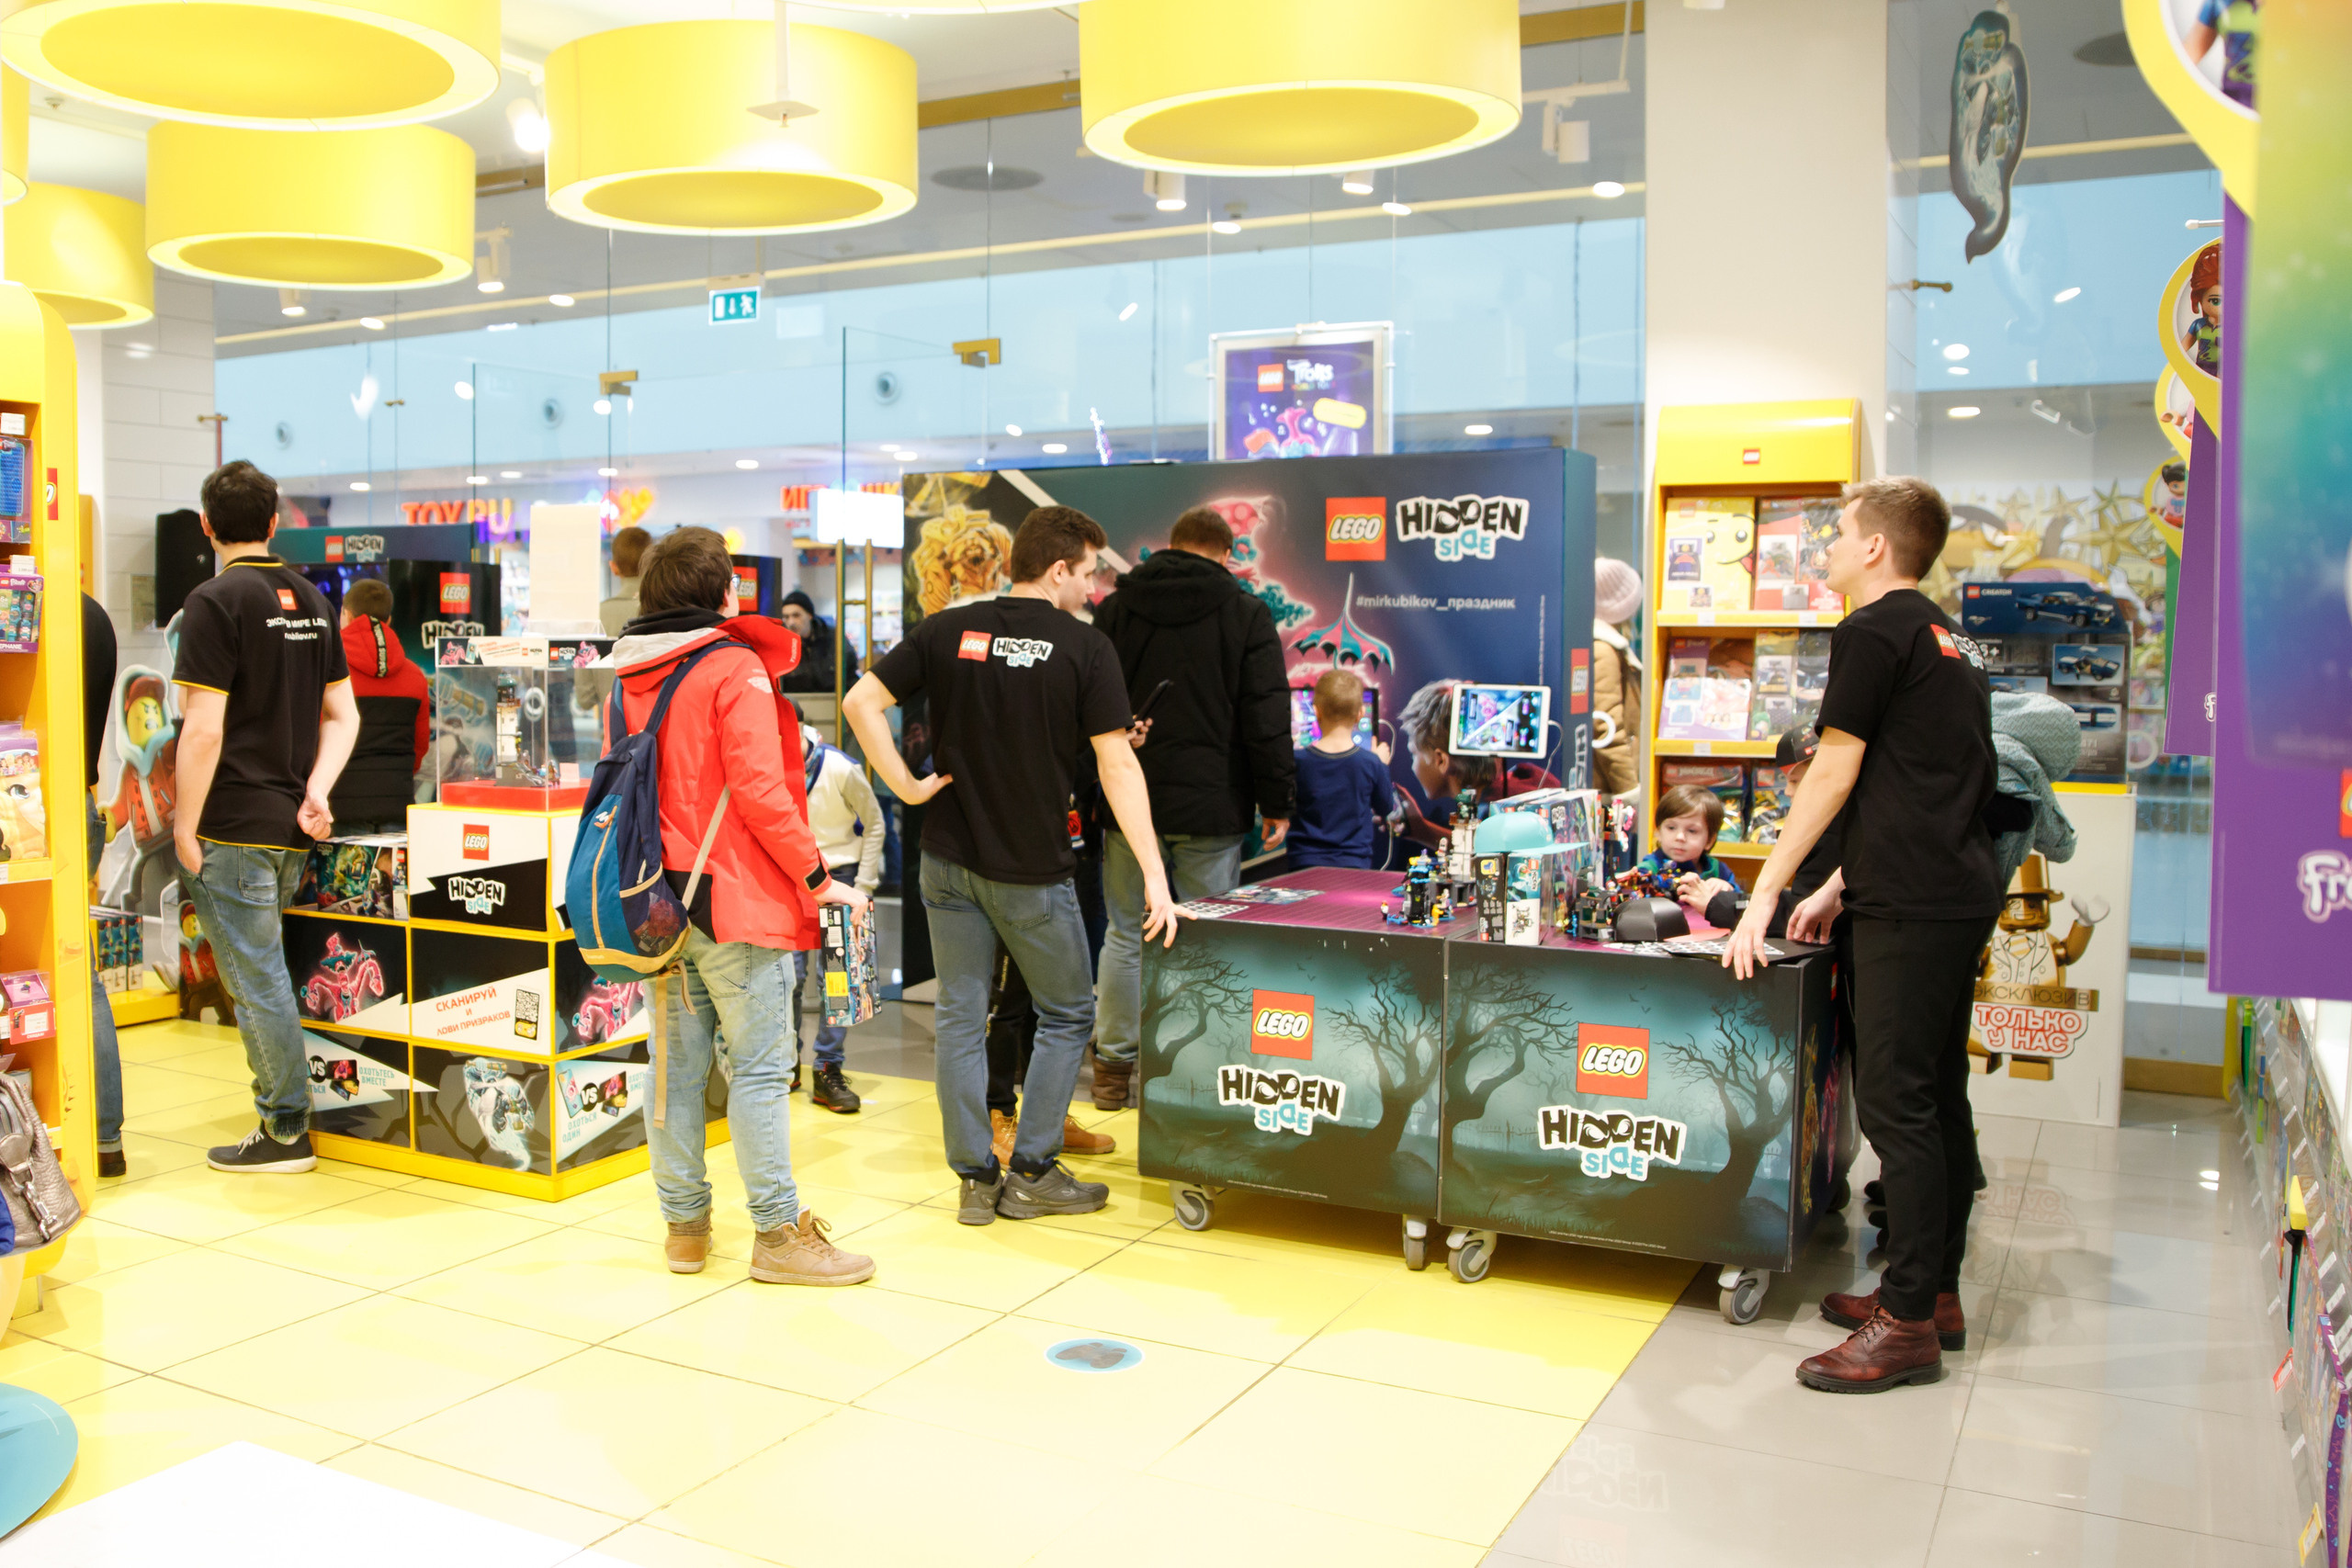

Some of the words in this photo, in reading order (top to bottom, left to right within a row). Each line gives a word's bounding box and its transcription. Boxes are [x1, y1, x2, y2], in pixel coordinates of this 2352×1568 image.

[1330, 516, 1383, 541] LEGO
[1401, 499, 1523, 536] HIDDEN
[1439, 528, 1490, 557] SIDE
[443, 586, 469, 601] LEGO
[960, 638, 989, 652] LEGO
[996, 638, 1050, 658] HIDDEN
[1008, 653, 1032, 666] SIDE
[464, 832, 489, 851] LEGO
[450, 878, 504, 903] HIDDEN
[467, 897, 492, 914] SIDE
[435, 986, 497, 1012] СКАНИРУЙ
[1973, 984, 2092, 1007] ЭКСКЛЮЗИВ
[436, 1023, 459, 1036] ЛОВИ
[460, 1010, 511, 1031] ПРИЗРАКОВ
[465, 1008, 473, 1016] И
[1256, 1010, 1308, 1038] LEGO
[1976, 1005, 2082, 1034] ТОЛЬКО
[1987, 1028, 2006, 1047] У
[2011, 1030, 2068, 1054] НАС
[308, 1060, 326, 1077] VS
[359, 1066, 395, 1079] ОХОТЬТЕСЬ
[1582, 1045, 1645, 1075] LEGO
[362, 1076, 387, 1087] ВМЕСТЕ
[1221, 1067, 1340, 1118] HIDDEN
[581, 1088, 598, 1106] VS
[1259, 1103, 1309, 1132] SIDE
[1542, 1109, 1680, 1161] HIDDEN
[1585, 1146, 1645, 1178] SIDE
